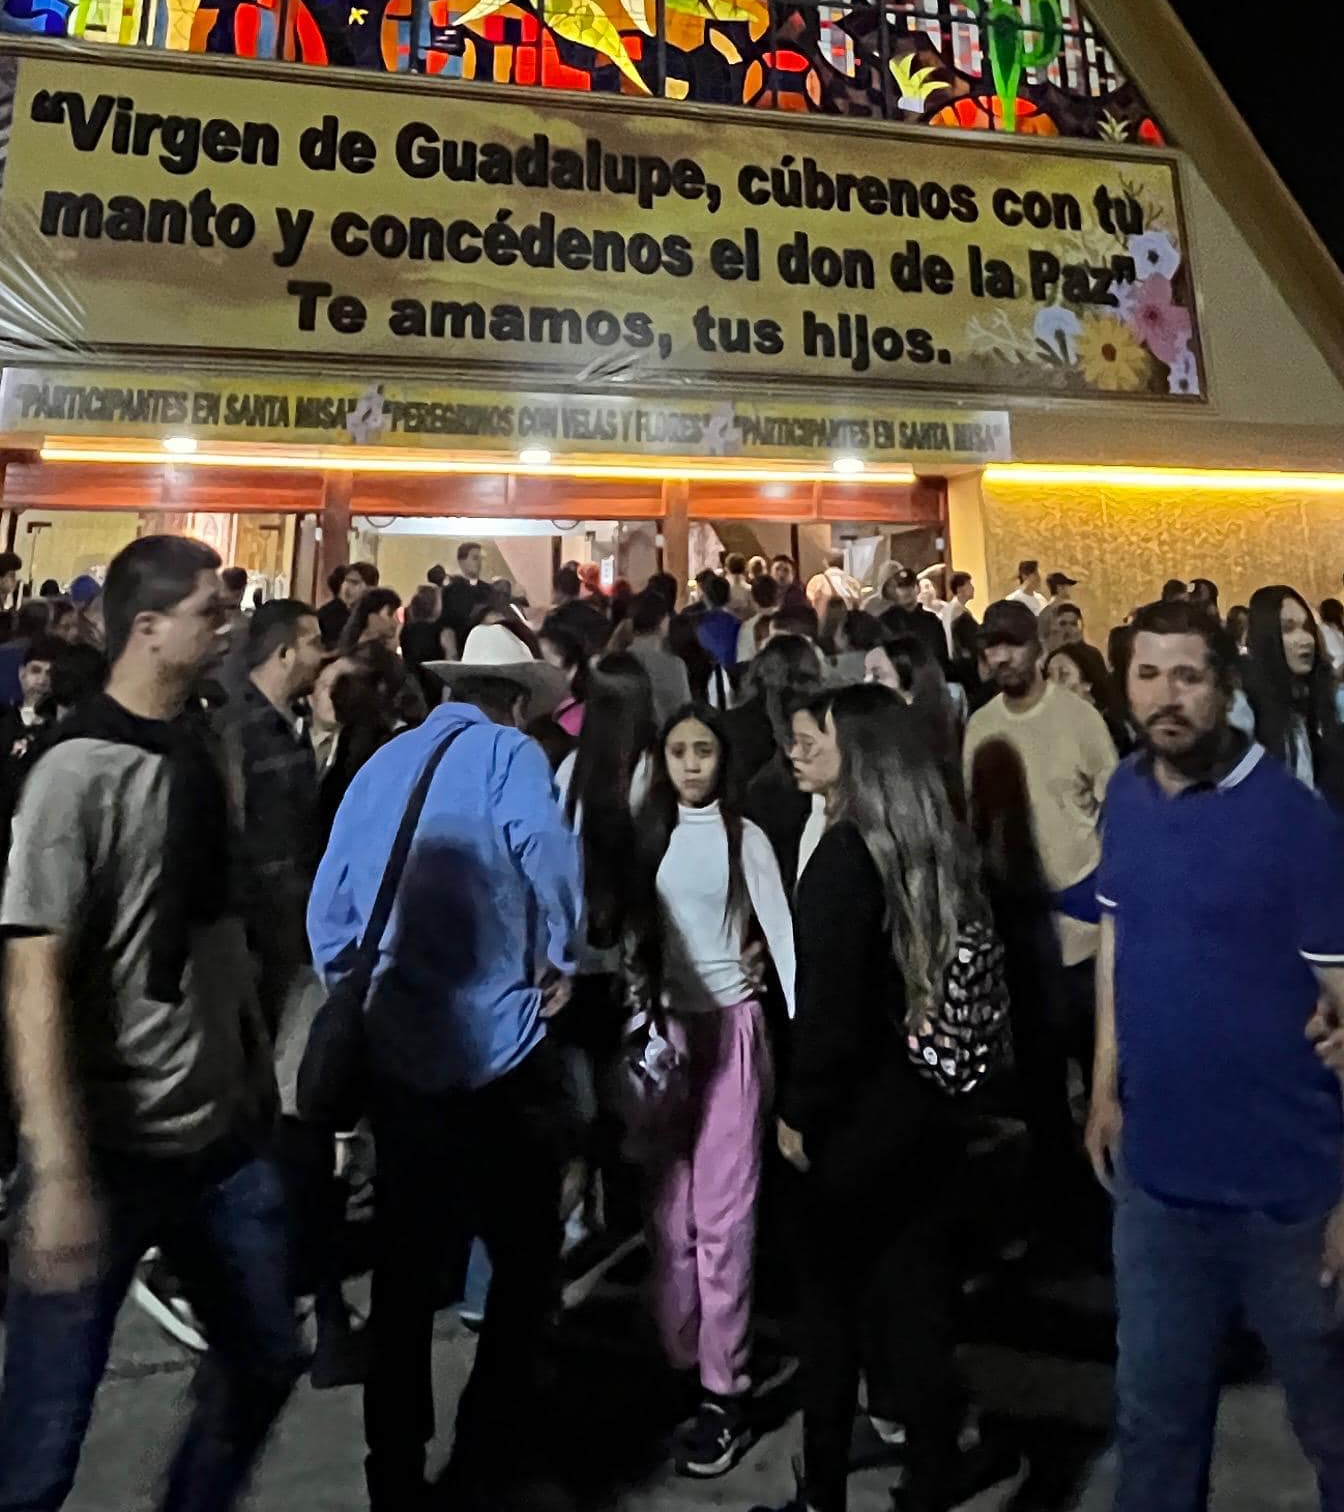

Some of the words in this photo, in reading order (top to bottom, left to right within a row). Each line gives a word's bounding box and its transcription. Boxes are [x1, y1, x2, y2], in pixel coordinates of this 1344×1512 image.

[299, 114, 377, 174] de
[395, 121, 722, 214] Guadalupe,
[737, 154, 979, 224] cúbrenos
[992, 187, 1083, 232] con
[1093, 184, 1144, 236] tu
[39, 187, 257, 249] manto
[272, 206, 315, 268] y
[330, 207, 693, 278] concédenos
[709, 228, 759, 282] el
[777, 231, 876, 289] don
[890, 240, 954, 297] de
[968, 245, 1016, 300] la
[287, 280, 367, 334] Te
[388, 291, 673, 358] amamos,
[692, 304, 784, 356] tus
[802, 310, 952, 371] hijos.
[191, 391, 222, 426] EN
[224, 392, 290, 428] SANTA
[560, 407, 618, 441] VELAS
[620, 410, 633, 443] Y
[873, 419, 896, 450] EN
[898, 419, 952, 452] SANTA
